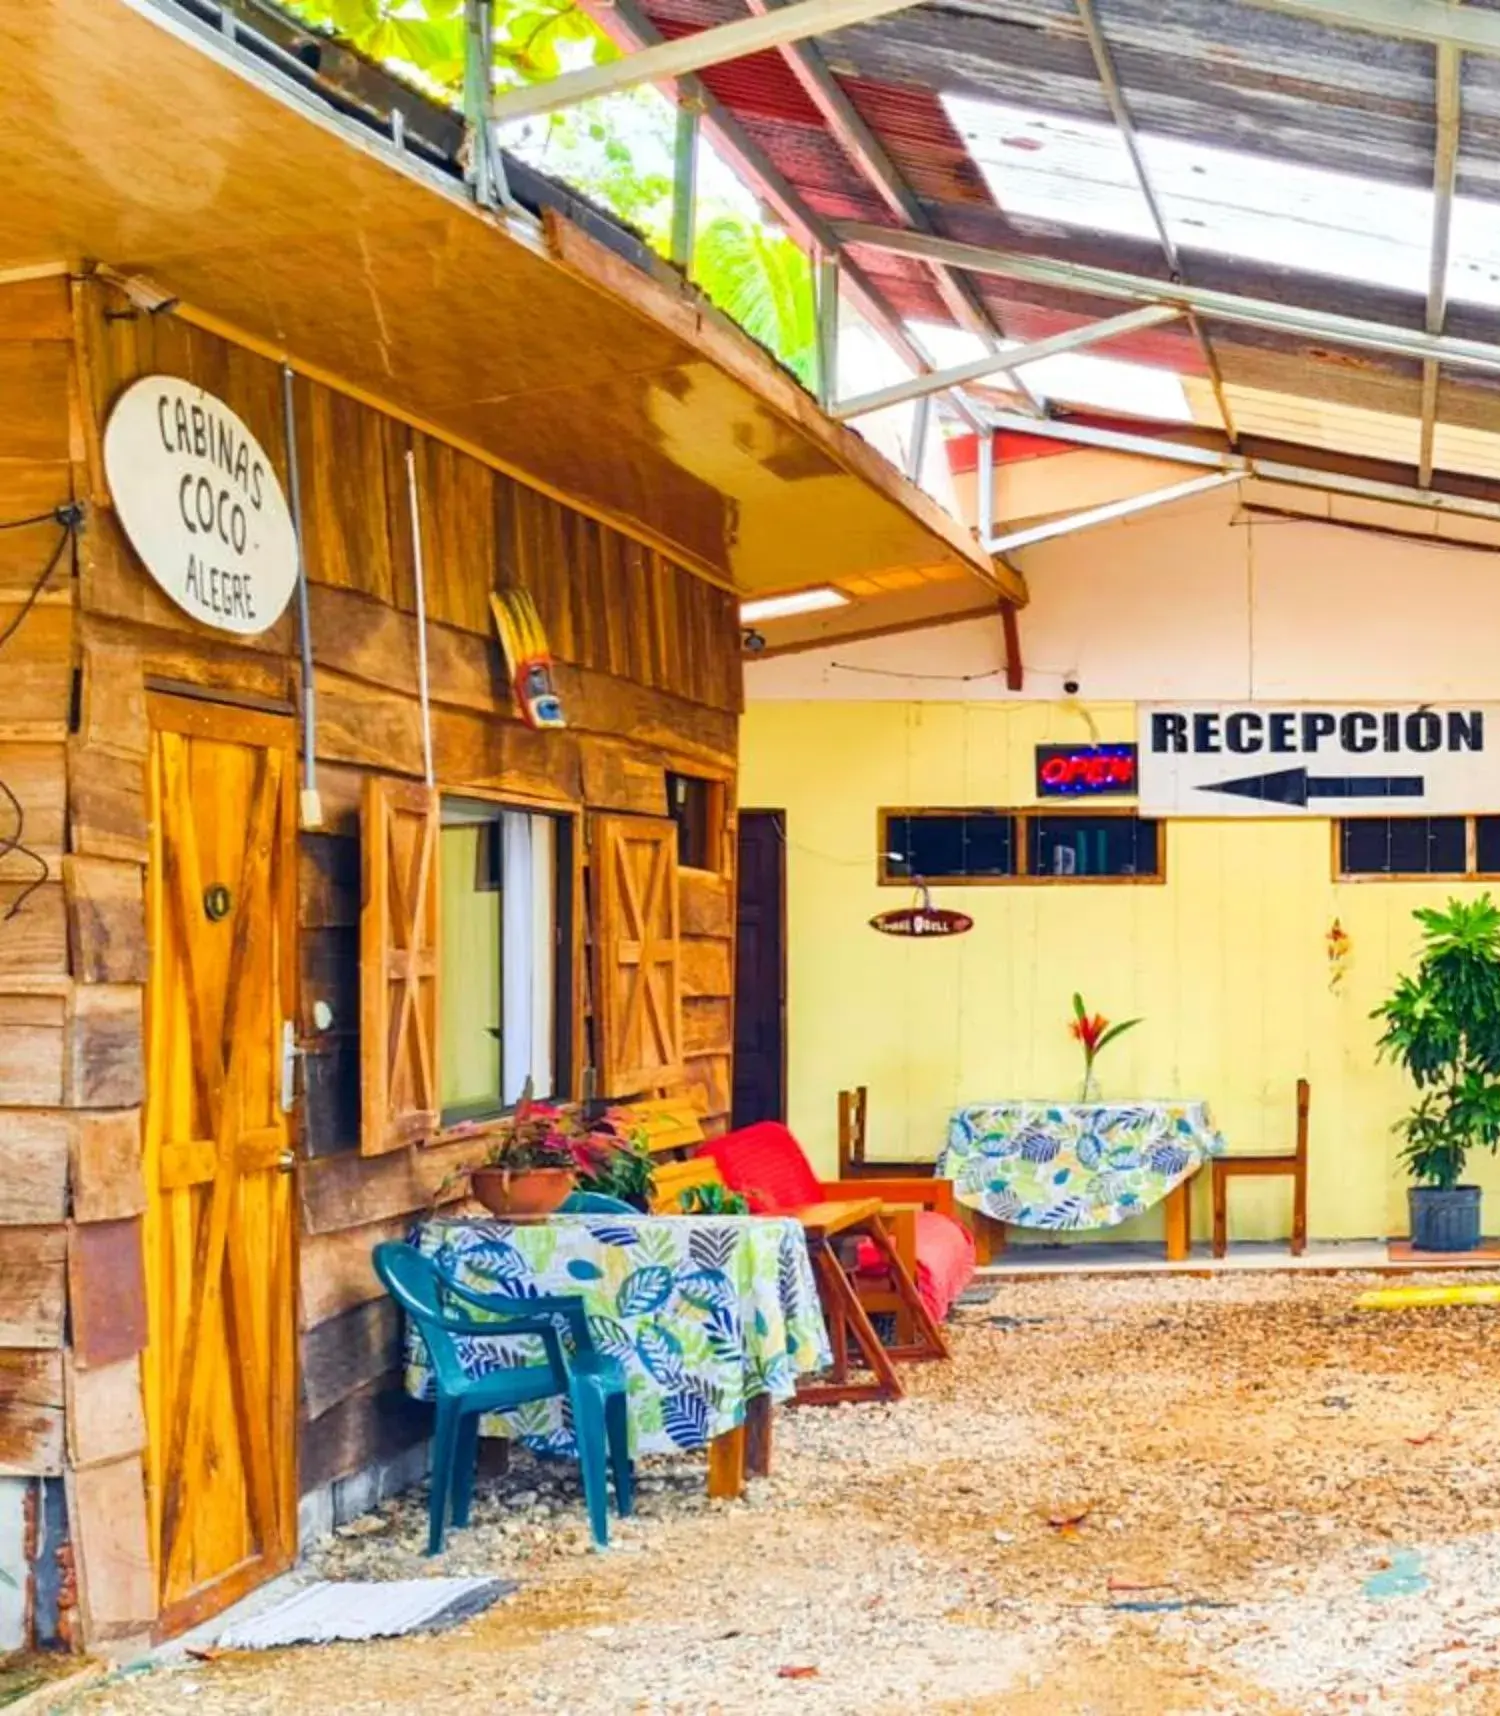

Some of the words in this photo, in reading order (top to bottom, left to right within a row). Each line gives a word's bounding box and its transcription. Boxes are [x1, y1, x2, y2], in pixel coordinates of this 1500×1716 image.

[157, 394, 265, 512] CABINAS
[178, 473, 247, 556] COCO
[185, 553, 257, 620] ALEGRE
[1151, 703, 1484, 755] RECEPCIÓN
[1041, 756, 1133, 784] OPEN
